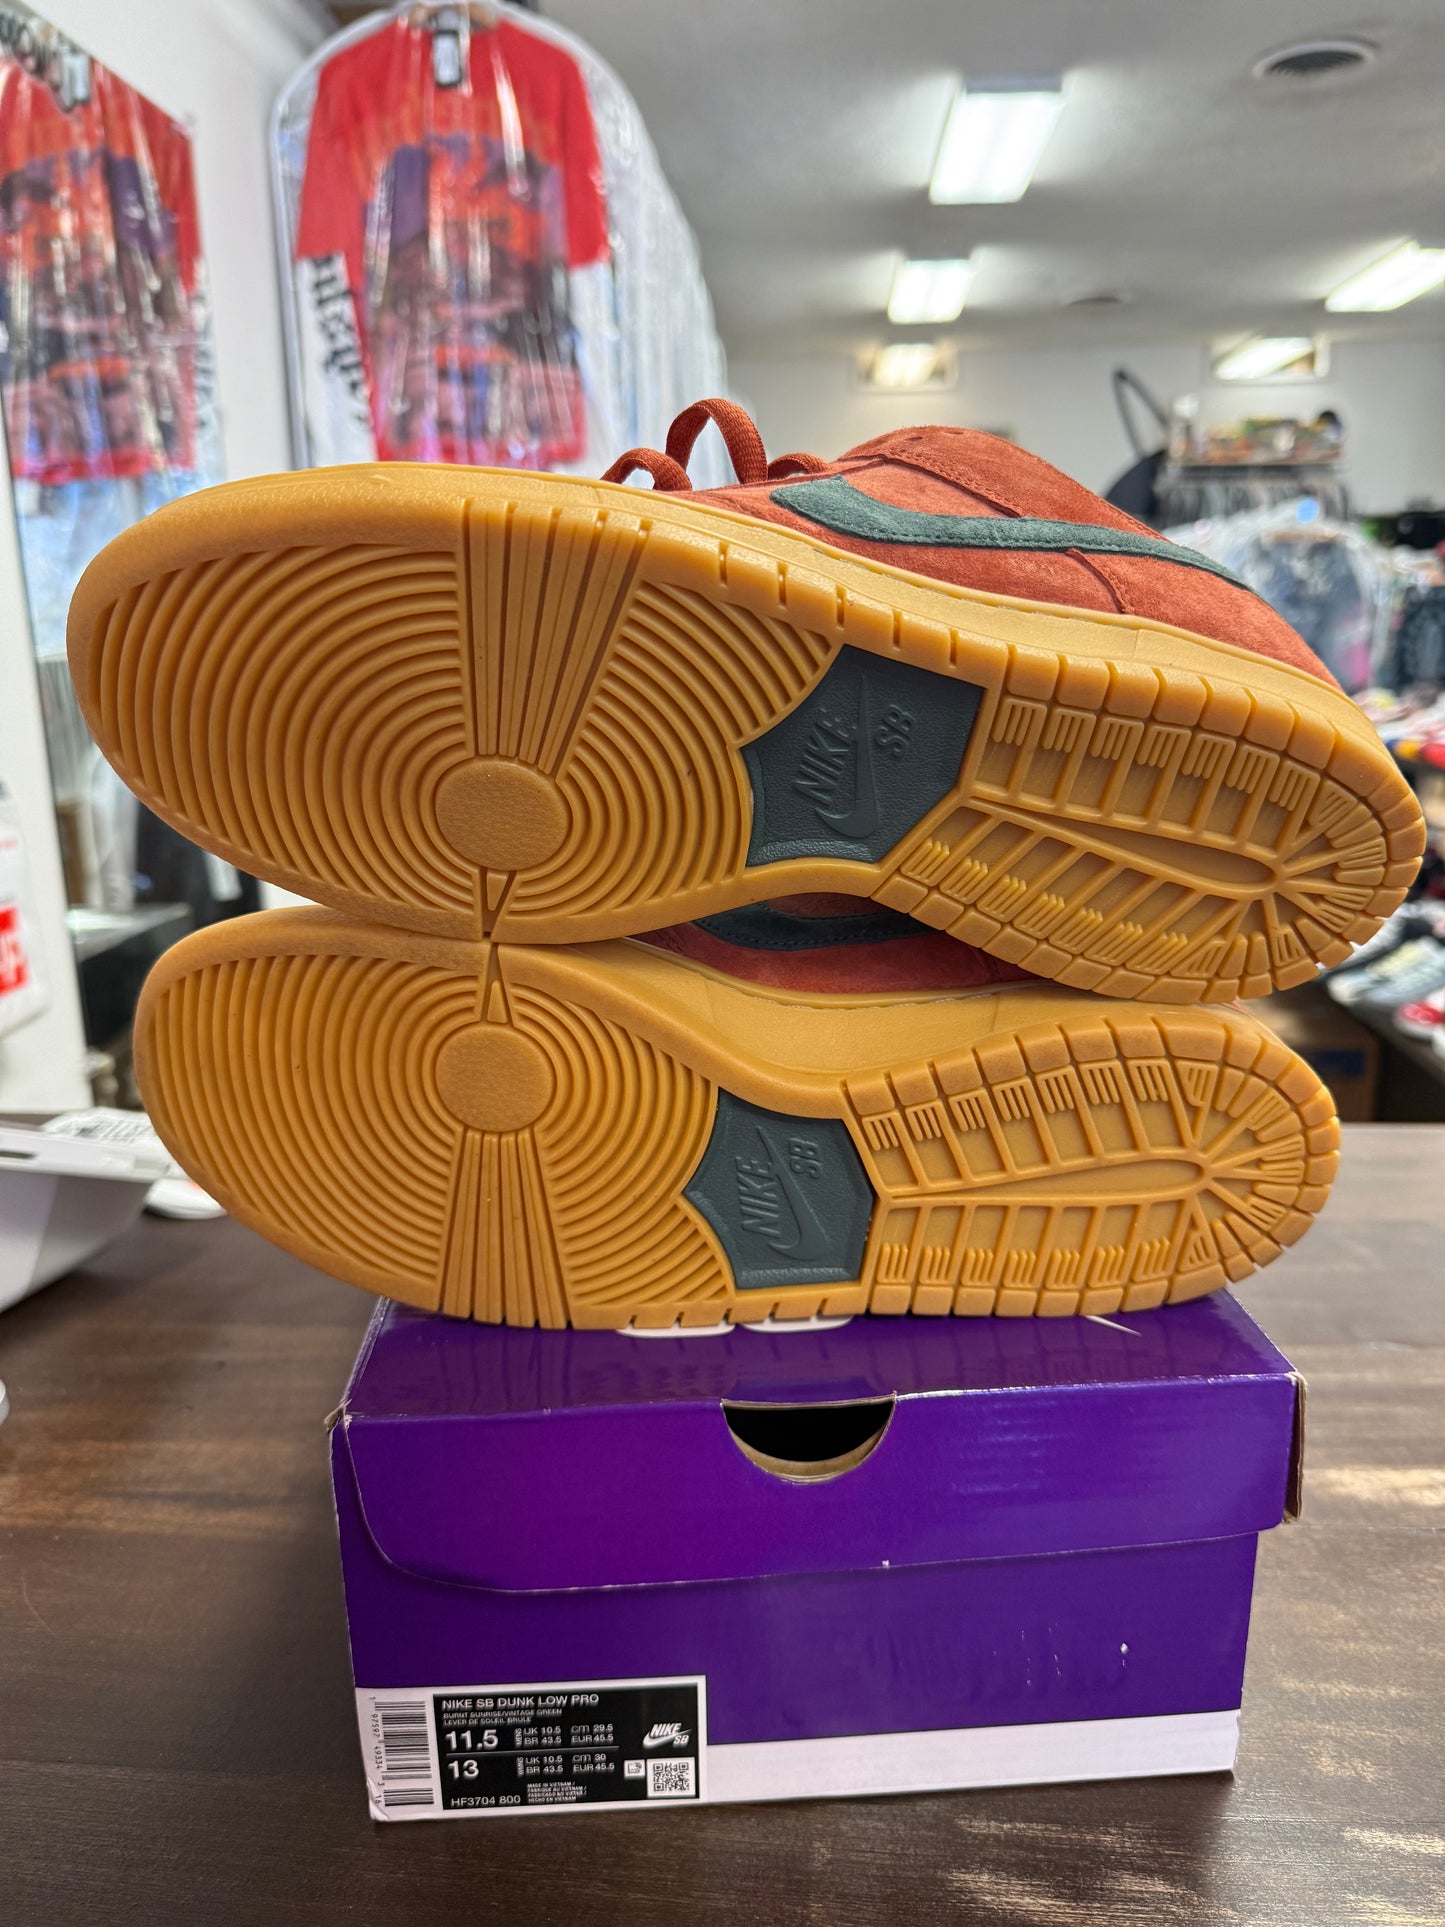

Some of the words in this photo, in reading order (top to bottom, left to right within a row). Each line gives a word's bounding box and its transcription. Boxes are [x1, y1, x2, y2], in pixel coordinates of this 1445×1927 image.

[875, 703, 918, 758] SB
[793, 706, 858, 804] NIKE
[788, 1136, 824, 1180] SB
[734, 1155, 781, 1240] NIKE
[441, 1699, 473, 1709] NIKE
[476, 1697, 494, 1708] SB
[497, 1696, 535, 1707] DUNK
[538, 1695, 568, 1706] LOW
[571, 1694, 599, 1705] PRO
[536, 1708, 562, 1716] GREEN
[371, 1713, 381, 1738] 97597
[523, 1727, 538, 1735] UK
[541, 1726, 562, 1734] 10.5
[593, 1724, 614, 1732] 29.5
[650, 1722, 682, 1736] NIKE
[445, 1729, 499, 1749] 11.5
[524, 1737, 539, 1745] BR
[541, 1736, 562, 1744] 43.5
[572, 1735, 593, 1743] EUR
[593, 1734, 614, 1742] 45.5
[673, 1735, 690, 1745] SB
[374, 1745, 383, 1770] 49334
[525, 1756, 540, 1764] UK
[543, 1755, 563, 1763] 10.5
[594, 1753, 607, 1761] 30
[448, 1759, 480, 1779] 13
[543, 1765, 564, 1773] 43.5
[595, 1762, 615, 1770] 45.5
[451, 1796, 496, 1807] HF3704
[499, 1795, 521, 1804] 800
